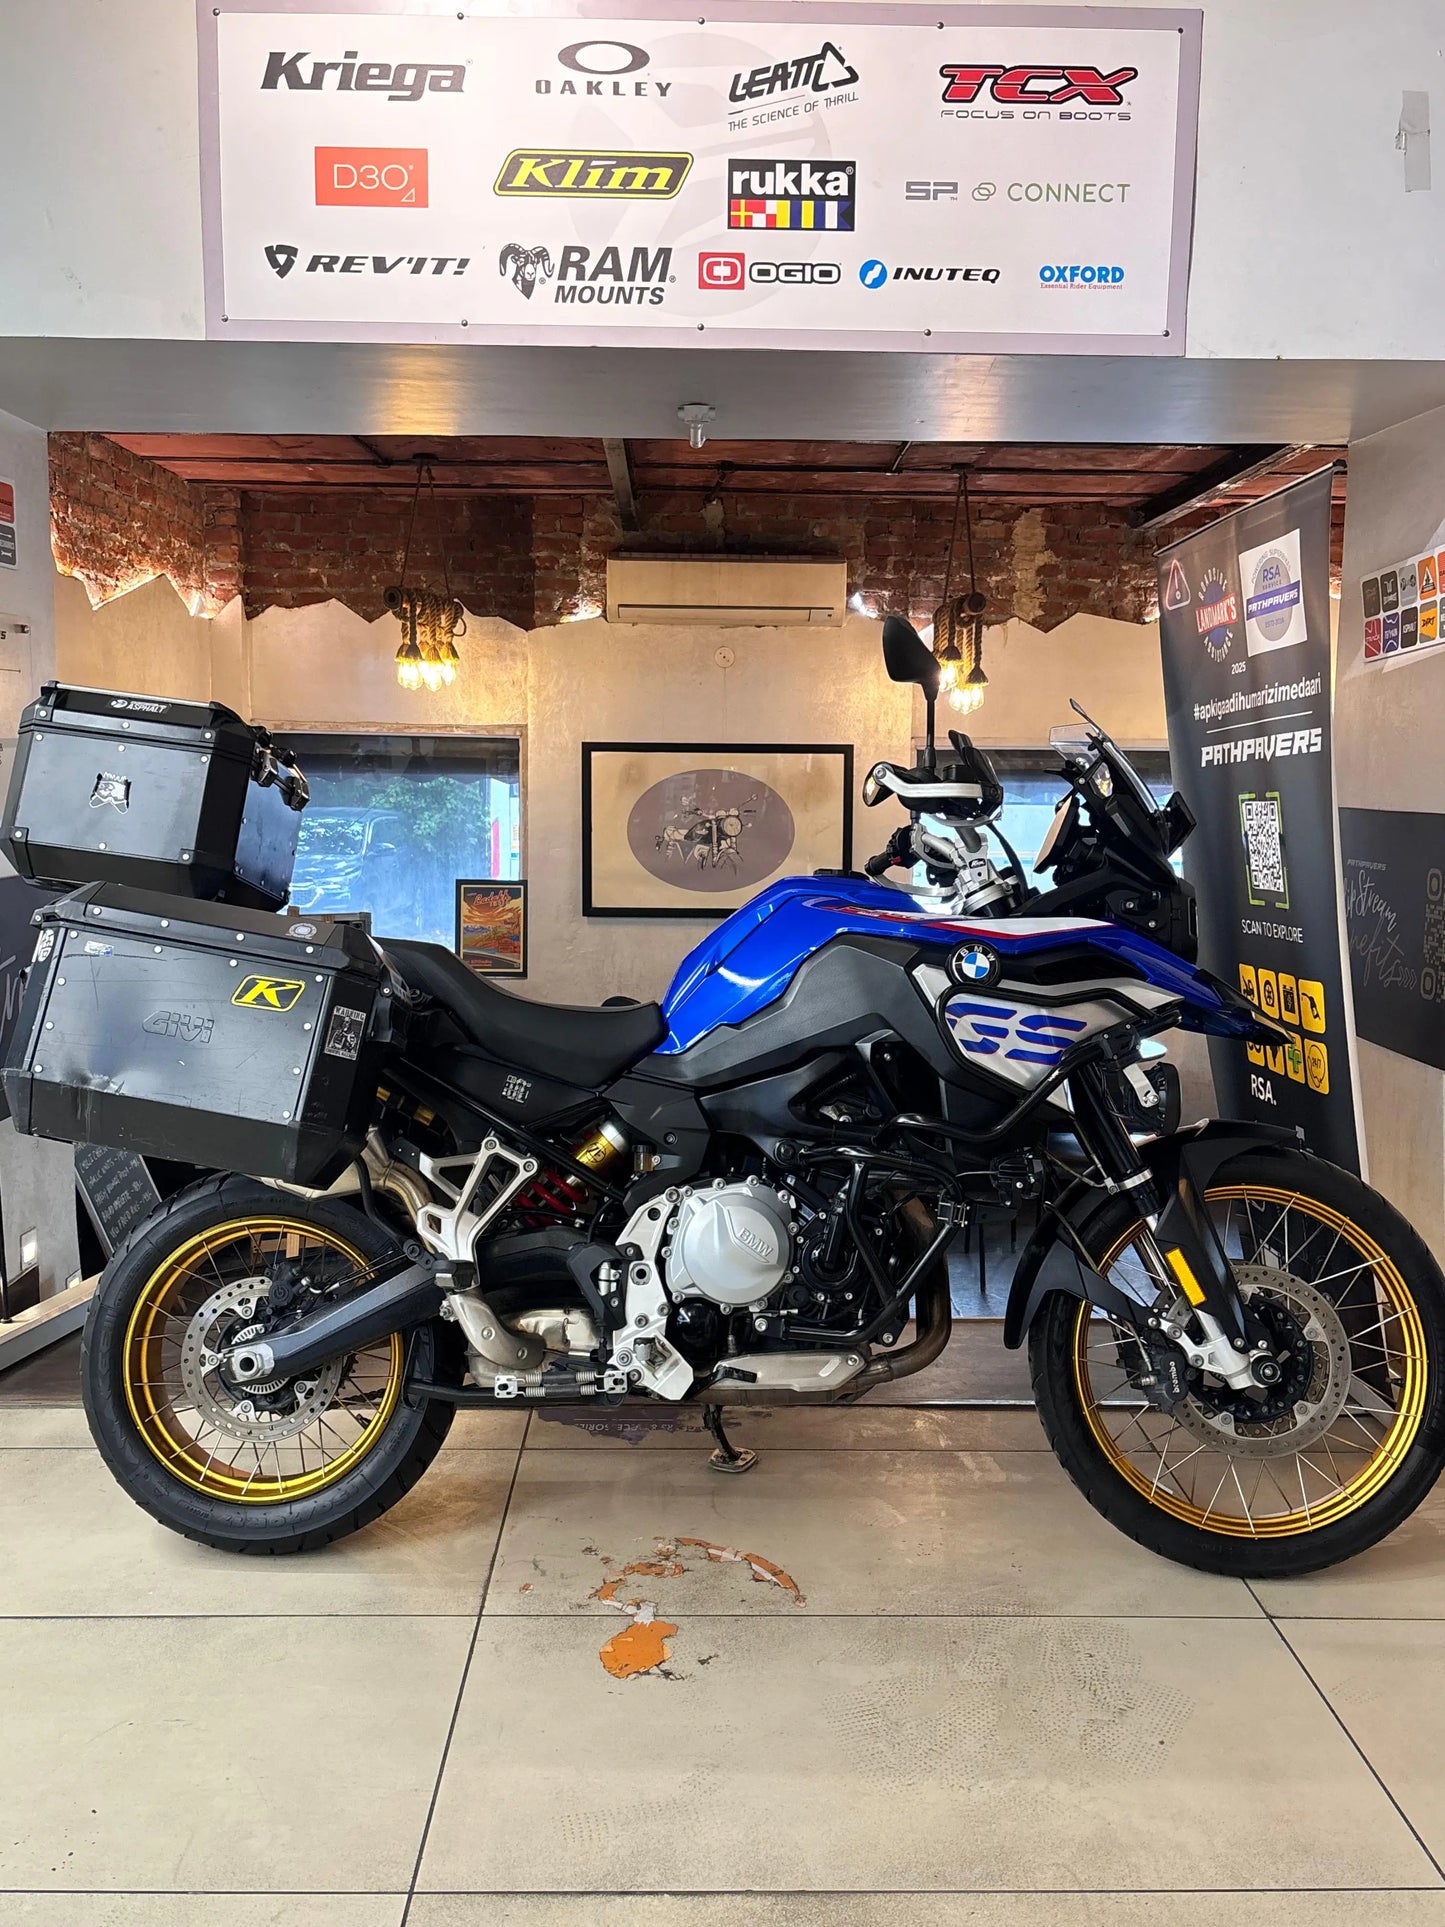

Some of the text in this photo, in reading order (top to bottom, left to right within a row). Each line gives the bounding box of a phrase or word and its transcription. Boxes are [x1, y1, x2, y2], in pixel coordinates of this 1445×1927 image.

[260, 51, 466, 101] Kriega
[535, 79, 673, 97] OAKLEY
[939, 64, 1138, 105] TCX
[728, 92, 859, 132] THE SCIENCE OF THRILL
[941, 110, 1015, 119] FOCUS
[1059, 112, 1132, 121] BOOTS
[507, 158, 675, 191] Klim
[732, 163, 849, 197] rukka
[905, 181, 1131, 203] SP CONNECT
[306, 254, 470, 276] REV'IT!
[557, 245, 673, 283] RAM
[749, 261, 842, 284] OGIO
[893, 266, 1001, 284] INUTEQ
[1039, 265, 1125, 283] OXFORD
[554, 285, 665, 305] MOUNTS
[1088, 283, 1123, 291] Equipment
[1262, 564, 1281, 582] RSA
[1248, 588, 1299, 613] PATHPAVERS
[1195, 595, 1238, 633] LANDMARK'S
[1231, 660, 1247, 675] 2025
[126, 703, 168, 714] ASPHALT
[1193, 671, 1322, 723] #apkigaadihumarizimedaari
[1201, 727, 1322, 768] PATHPAVERS
[1241, 919, 1304, 944] SCAN TO EXPLORE
[959, 945, 997, 962] BMW
[944, 1002, 1088, 1066] GS
[1311, 1056, 1322, 1070] 24/7
[1251, 1073, 1277, 1106] RSA.
[739, 1227, 774, 1257] BMW
[1168, 1360, 1181, 1394] brembo
